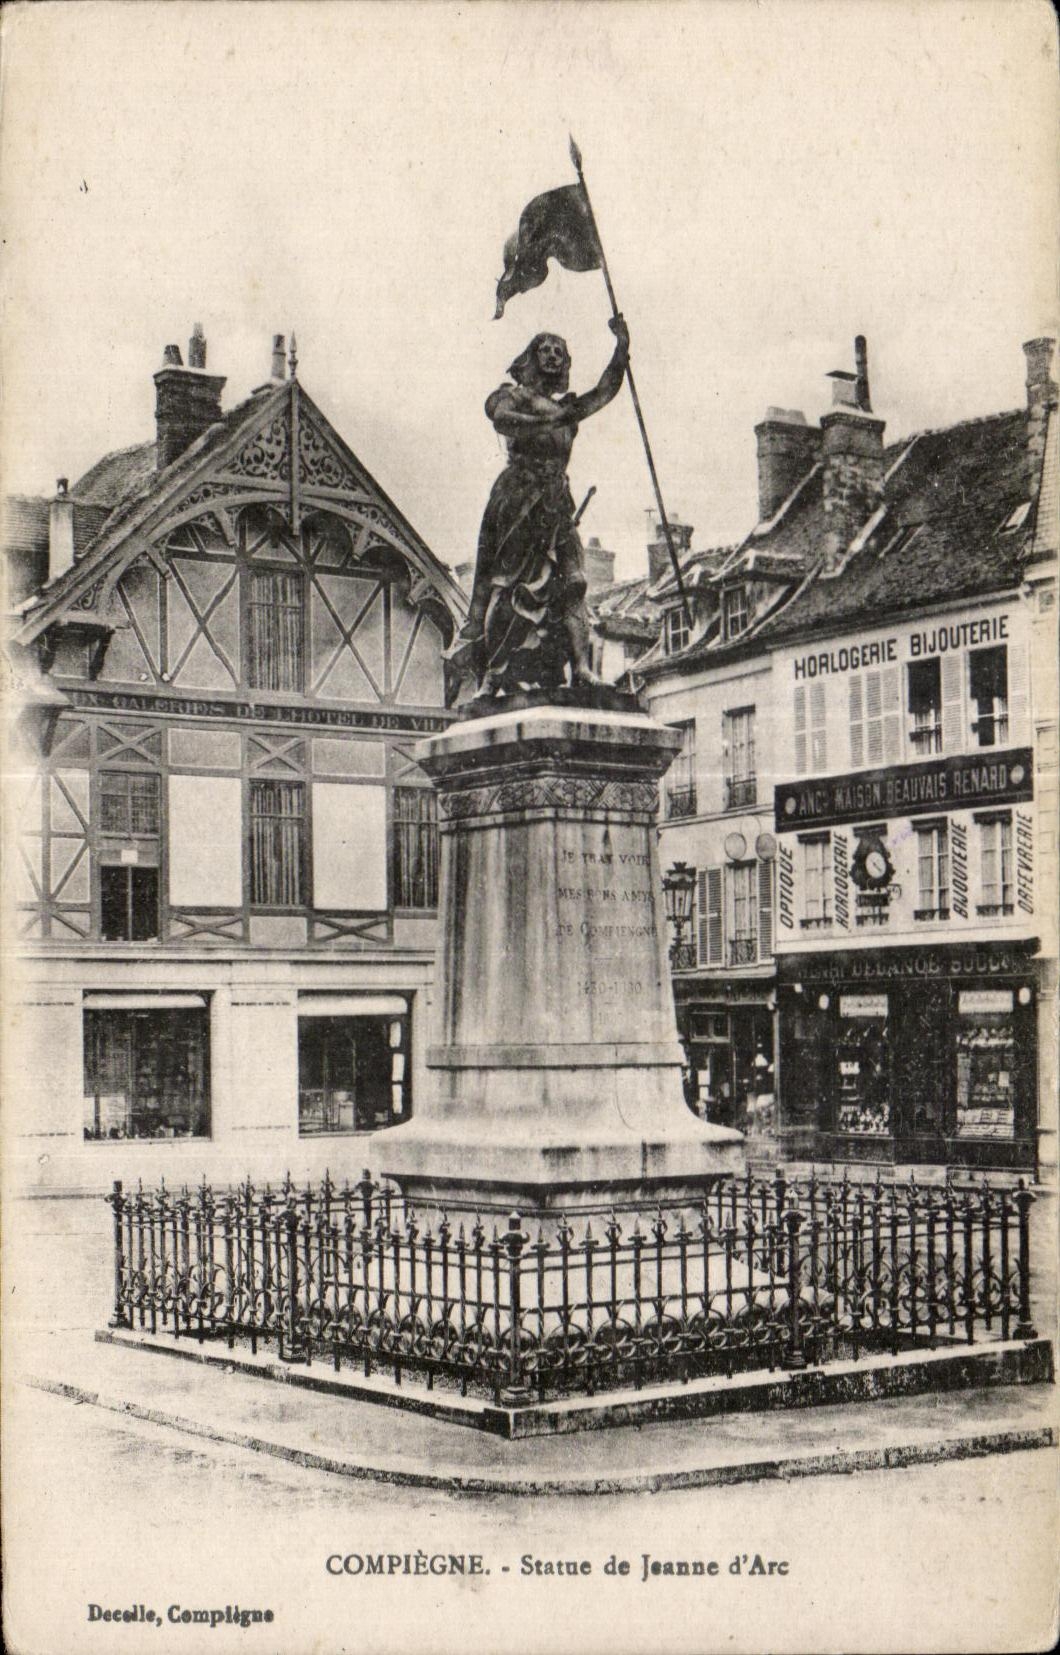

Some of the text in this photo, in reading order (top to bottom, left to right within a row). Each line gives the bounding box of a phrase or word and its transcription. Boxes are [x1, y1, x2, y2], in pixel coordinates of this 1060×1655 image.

[794, 614, 1010, 680] HORLOGERIE BIJOUTERIE
[236, 704, 265, 719] DE
[372, 715, 399, 729] DE
[886, 774, 947, 804] BEAUVAIS
[953, 764, 1007, 795] RENARD
[561, 850, 575, 864] JE
[778, 840, 794, 929] OPTIQUE
[833, 831, 849, 929] HORLOGERIE
[952, 818, 968, 919] BIJOUTERIE
[1017, 810, 1033, 914] ORFEVRERIE
